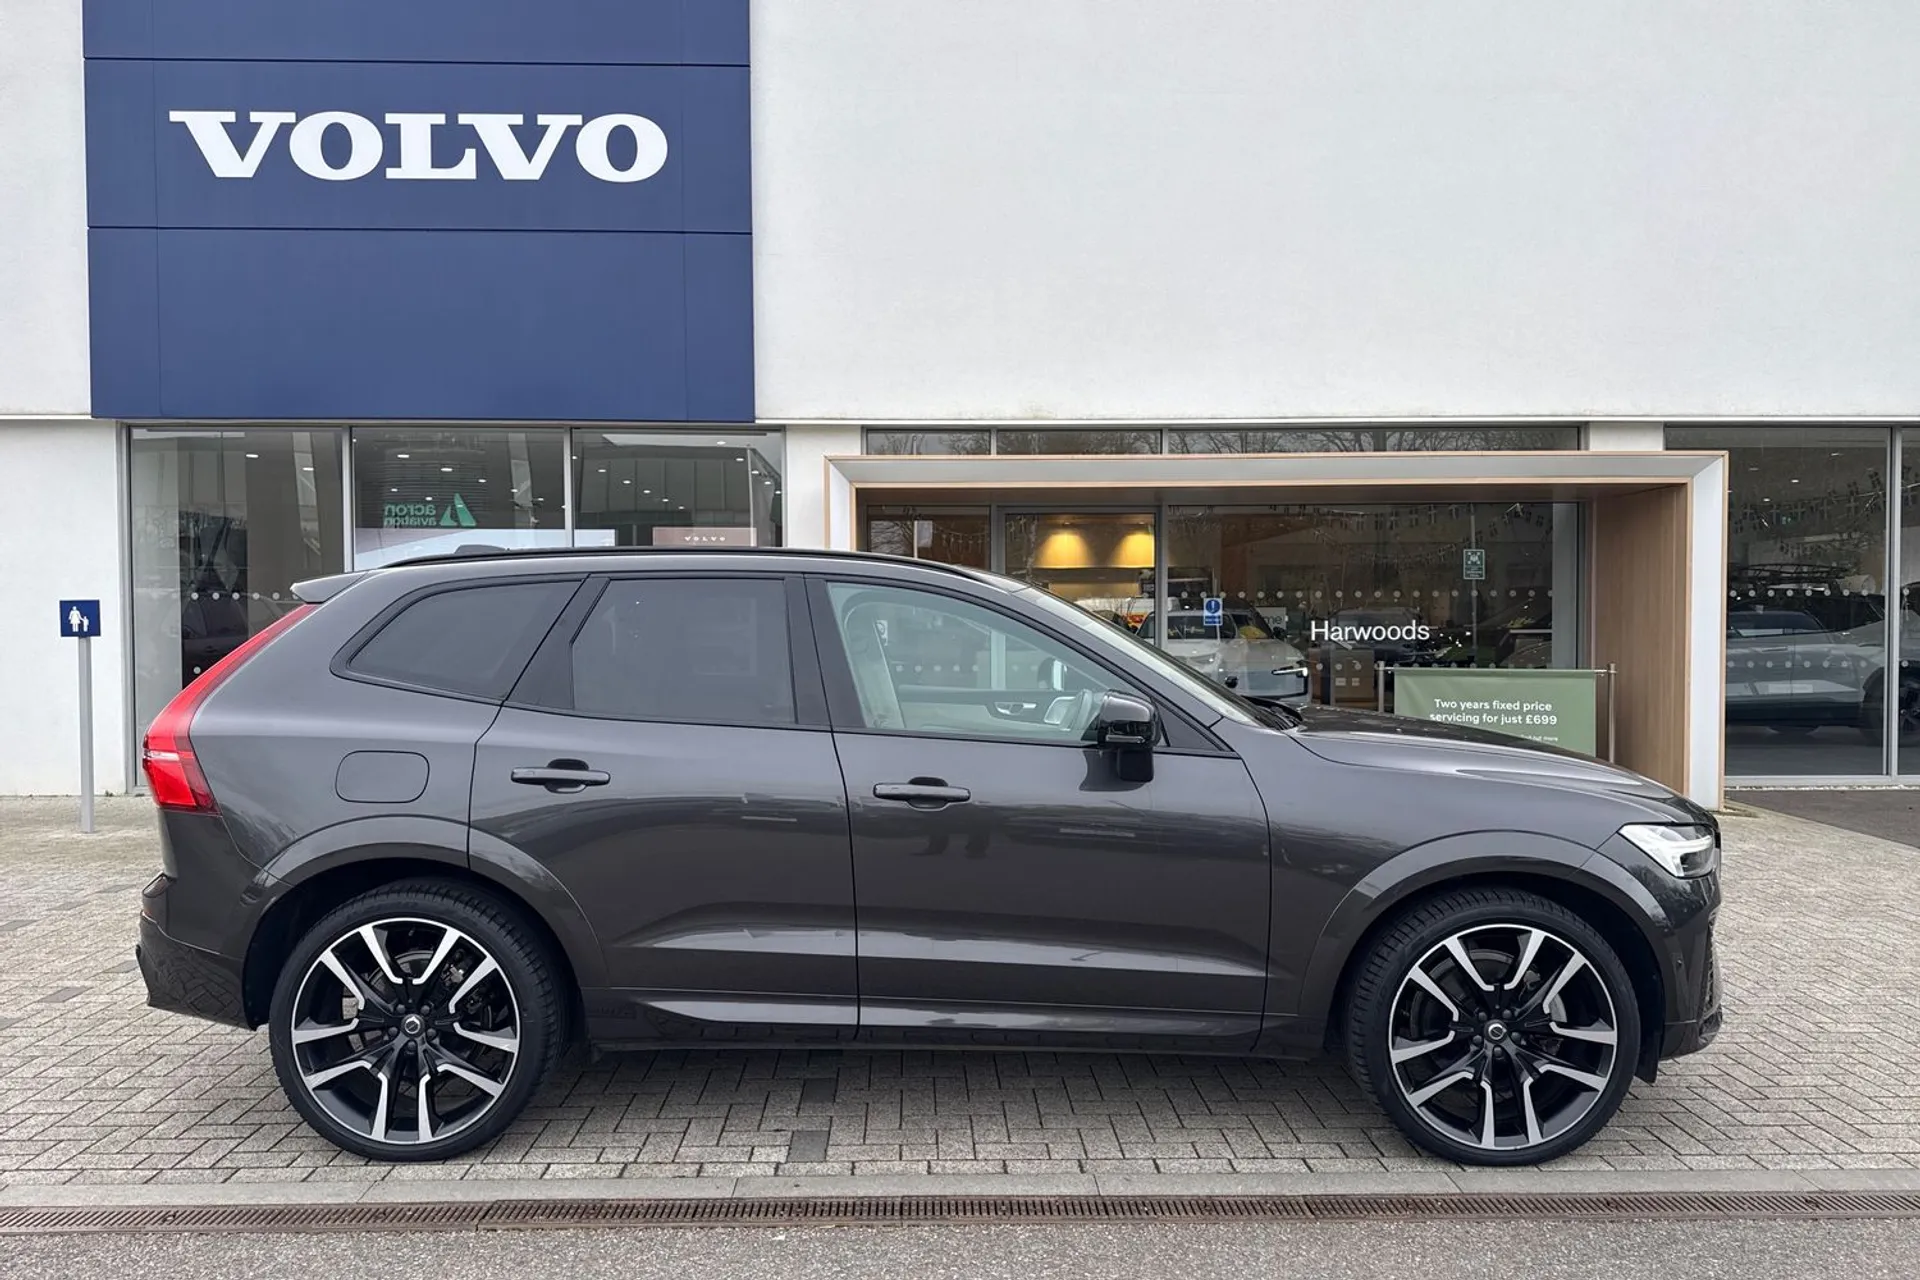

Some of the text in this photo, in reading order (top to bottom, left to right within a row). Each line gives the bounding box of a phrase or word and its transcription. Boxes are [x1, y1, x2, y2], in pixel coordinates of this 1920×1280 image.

[169, 110, 668, 183] VOLVO
[1311, 619, 1430, 641] Harwoods
[1434, 698, 1553, 713] Two years fixed price
[1429, 713, 1558, 726] servicing for just £699
